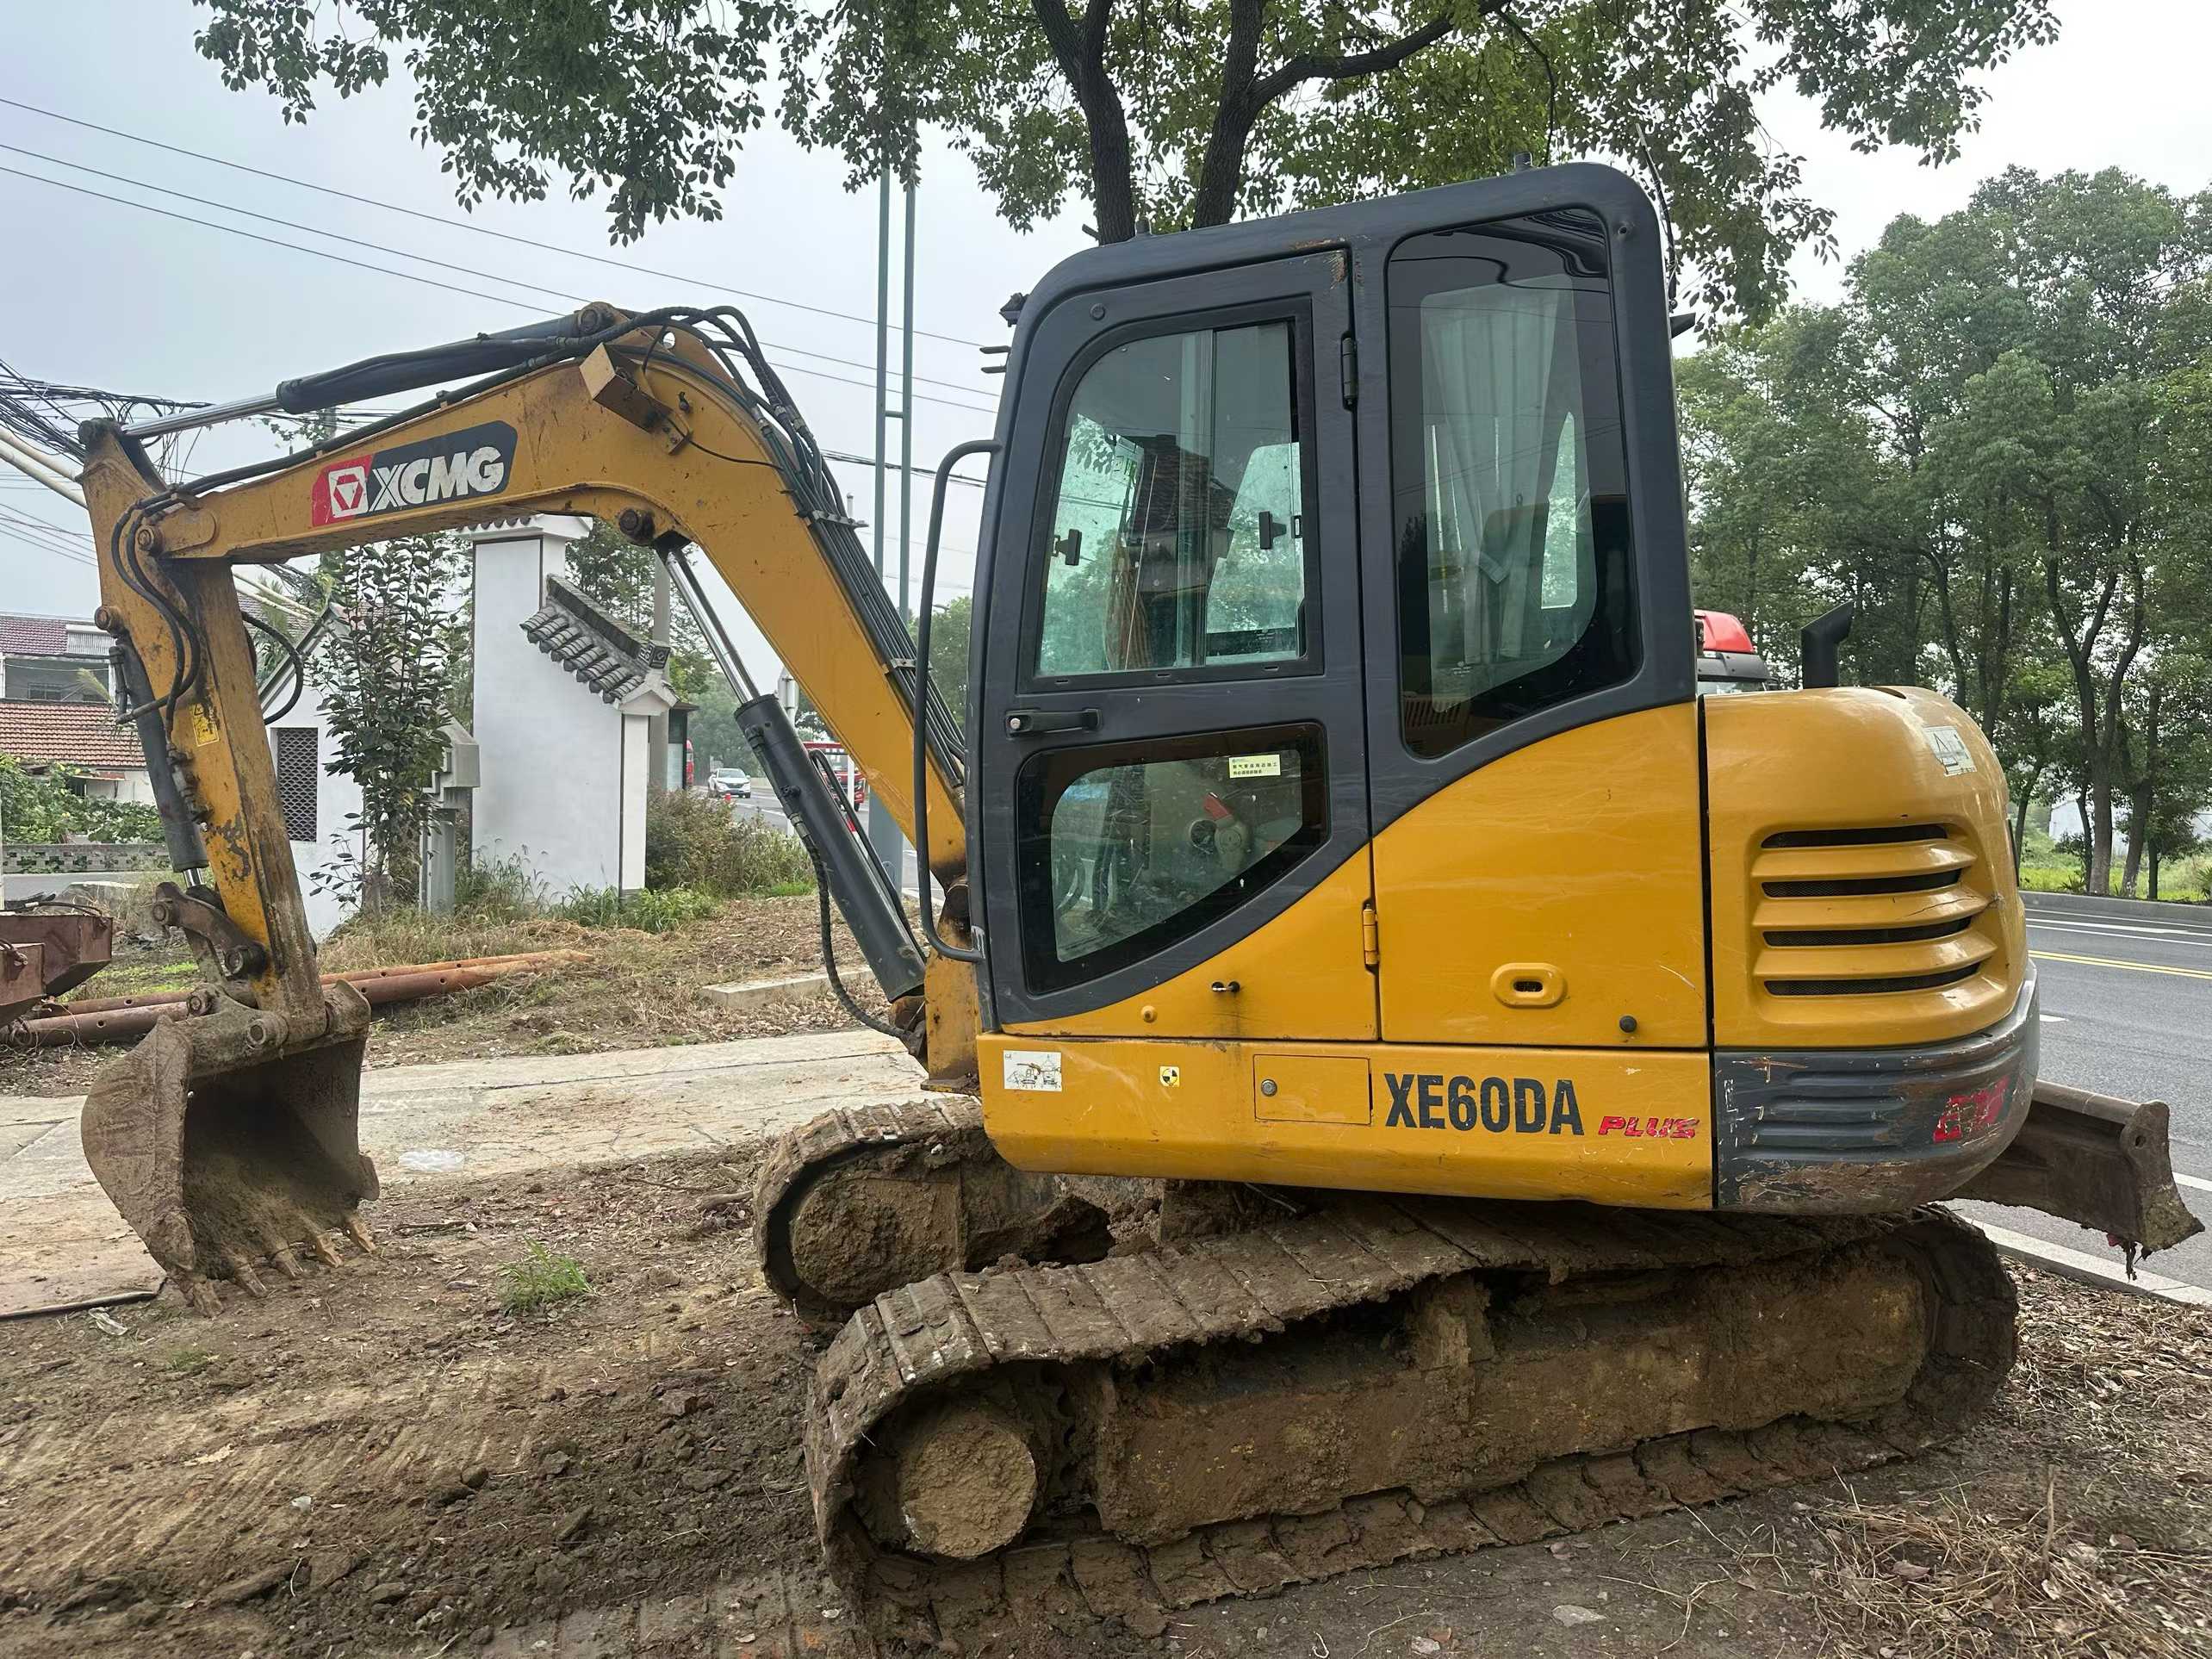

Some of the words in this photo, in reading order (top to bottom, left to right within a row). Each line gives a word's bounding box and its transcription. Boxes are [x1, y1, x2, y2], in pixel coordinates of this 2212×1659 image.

[369, 446, 504, 513] XCMG
[1383, 1072, 1585, 1136] XE60DA
[1598, 1115, 1699, 1139] PLUS
